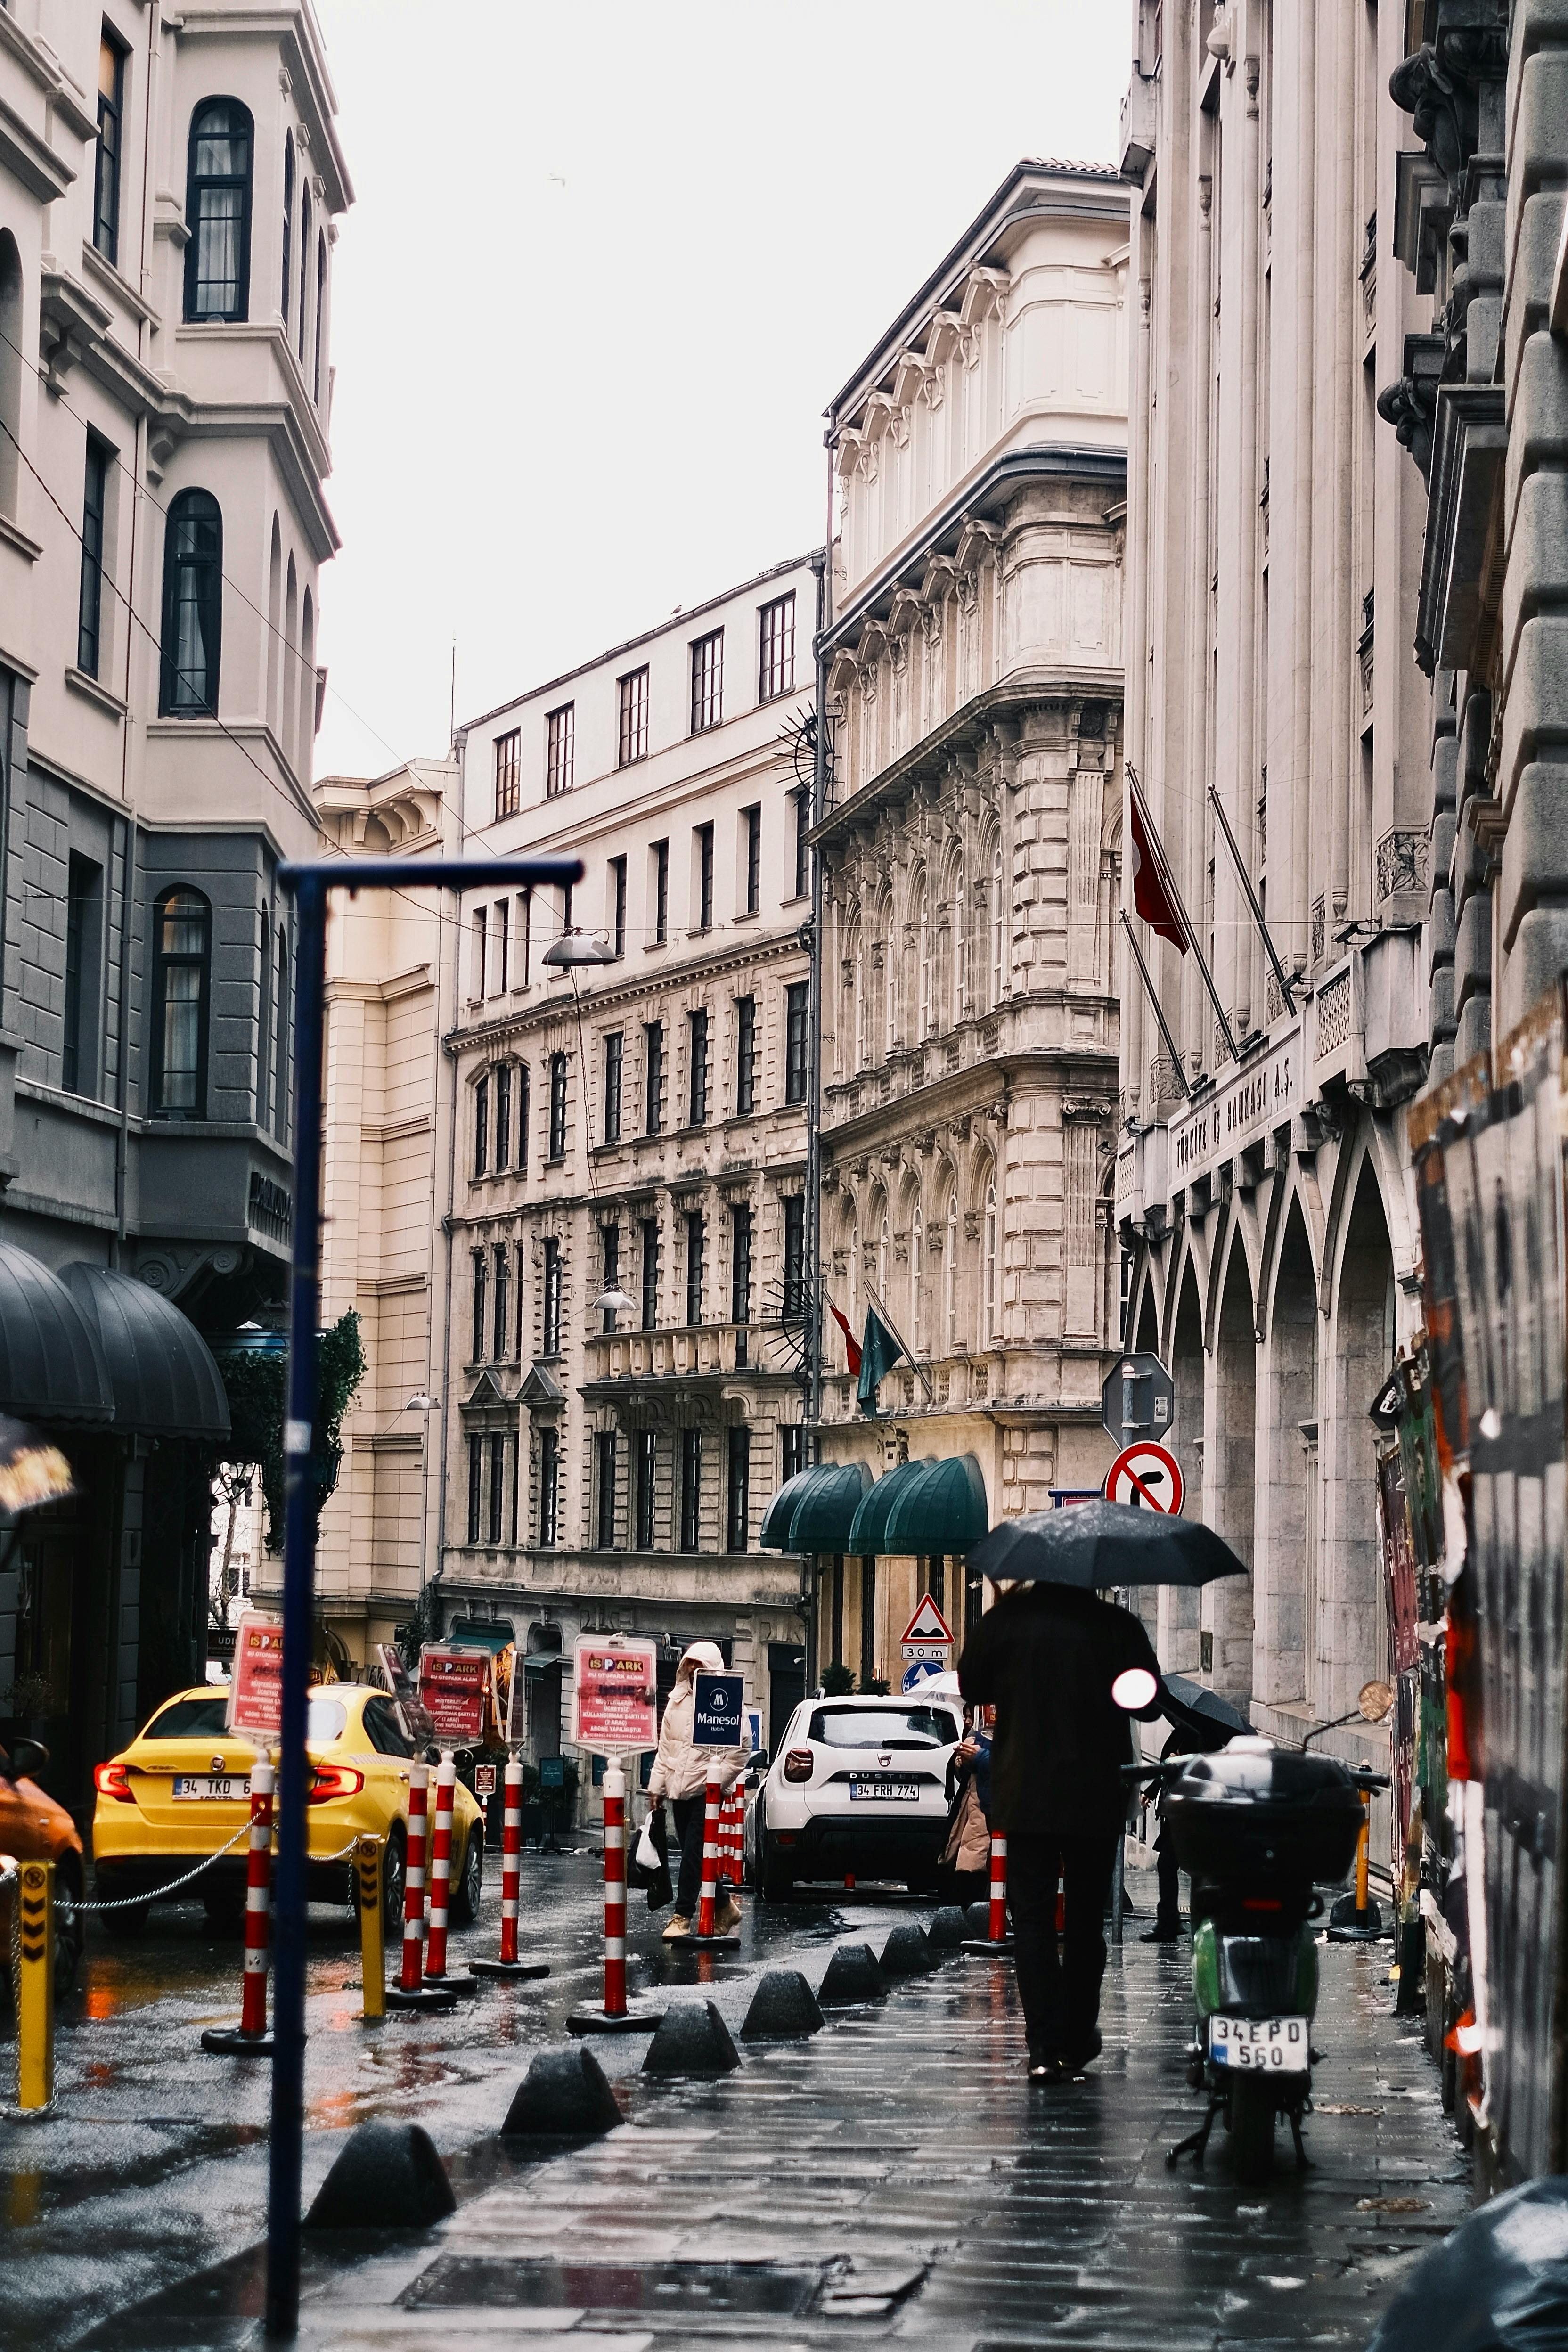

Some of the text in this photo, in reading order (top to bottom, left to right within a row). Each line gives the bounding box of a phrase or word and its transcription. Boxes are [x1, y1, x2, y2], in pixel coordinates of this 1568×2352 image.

[1177, 1117, 1207, 1168] TÜRKİYE
[1214, 1103, 1220, 1144] İŞ
[1227, 1072, 1266, 1131] BANKASI
[907, 1648, 924, 1657] 30
[697, 1712, 739, 1725] Manesol
[183, 1780, 252, 1794] 34 TKD 6
[858, 1785, 915, 1796] 34 FRH 774
[1239, 2045, 1282, 2066] 560
